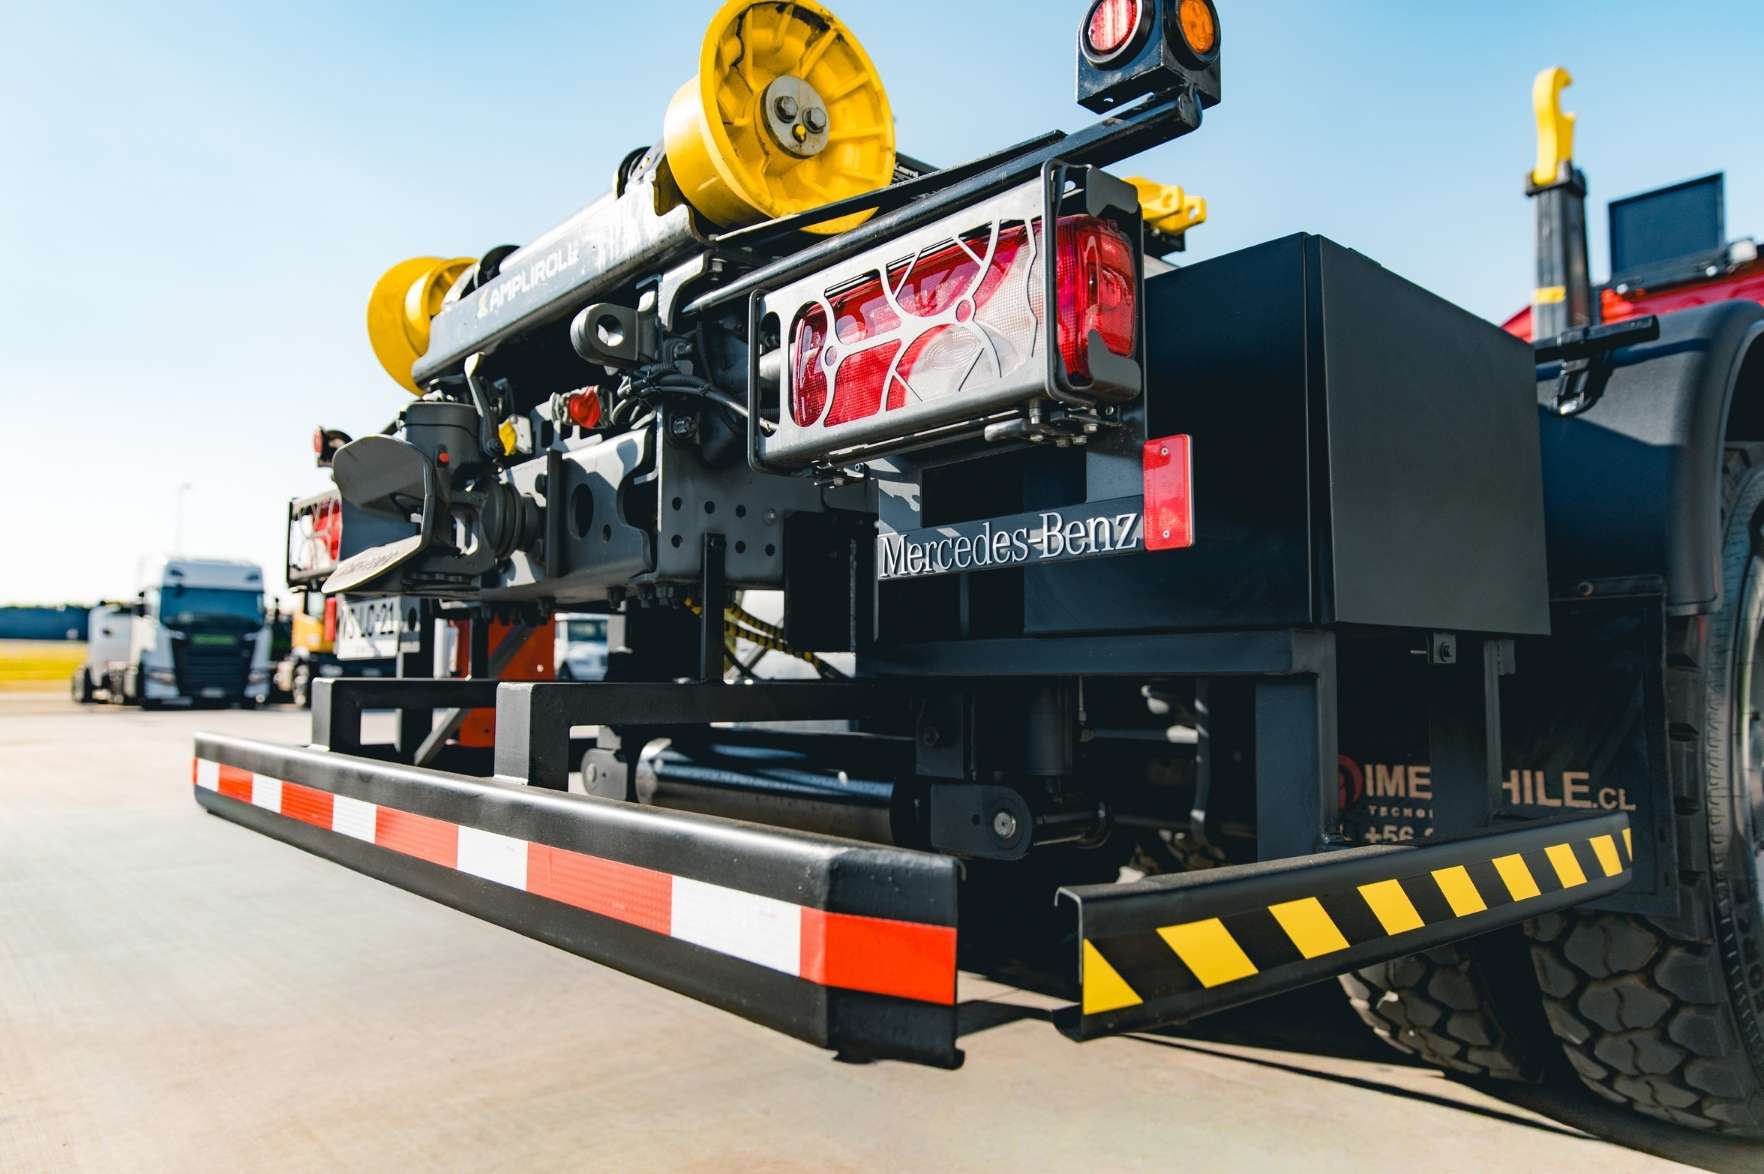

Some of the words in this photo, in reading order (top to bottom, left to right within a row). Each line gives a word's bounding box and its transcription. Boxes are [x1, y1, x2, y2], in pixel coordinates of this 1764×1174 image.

[878, 511, 1140, 578] Mercedes-Benz
[1364, 763, 1433, 800] IME
[1501, 768, 1637, 812] HILE.CL
[1367, 804, 1433, 819] TECNO
